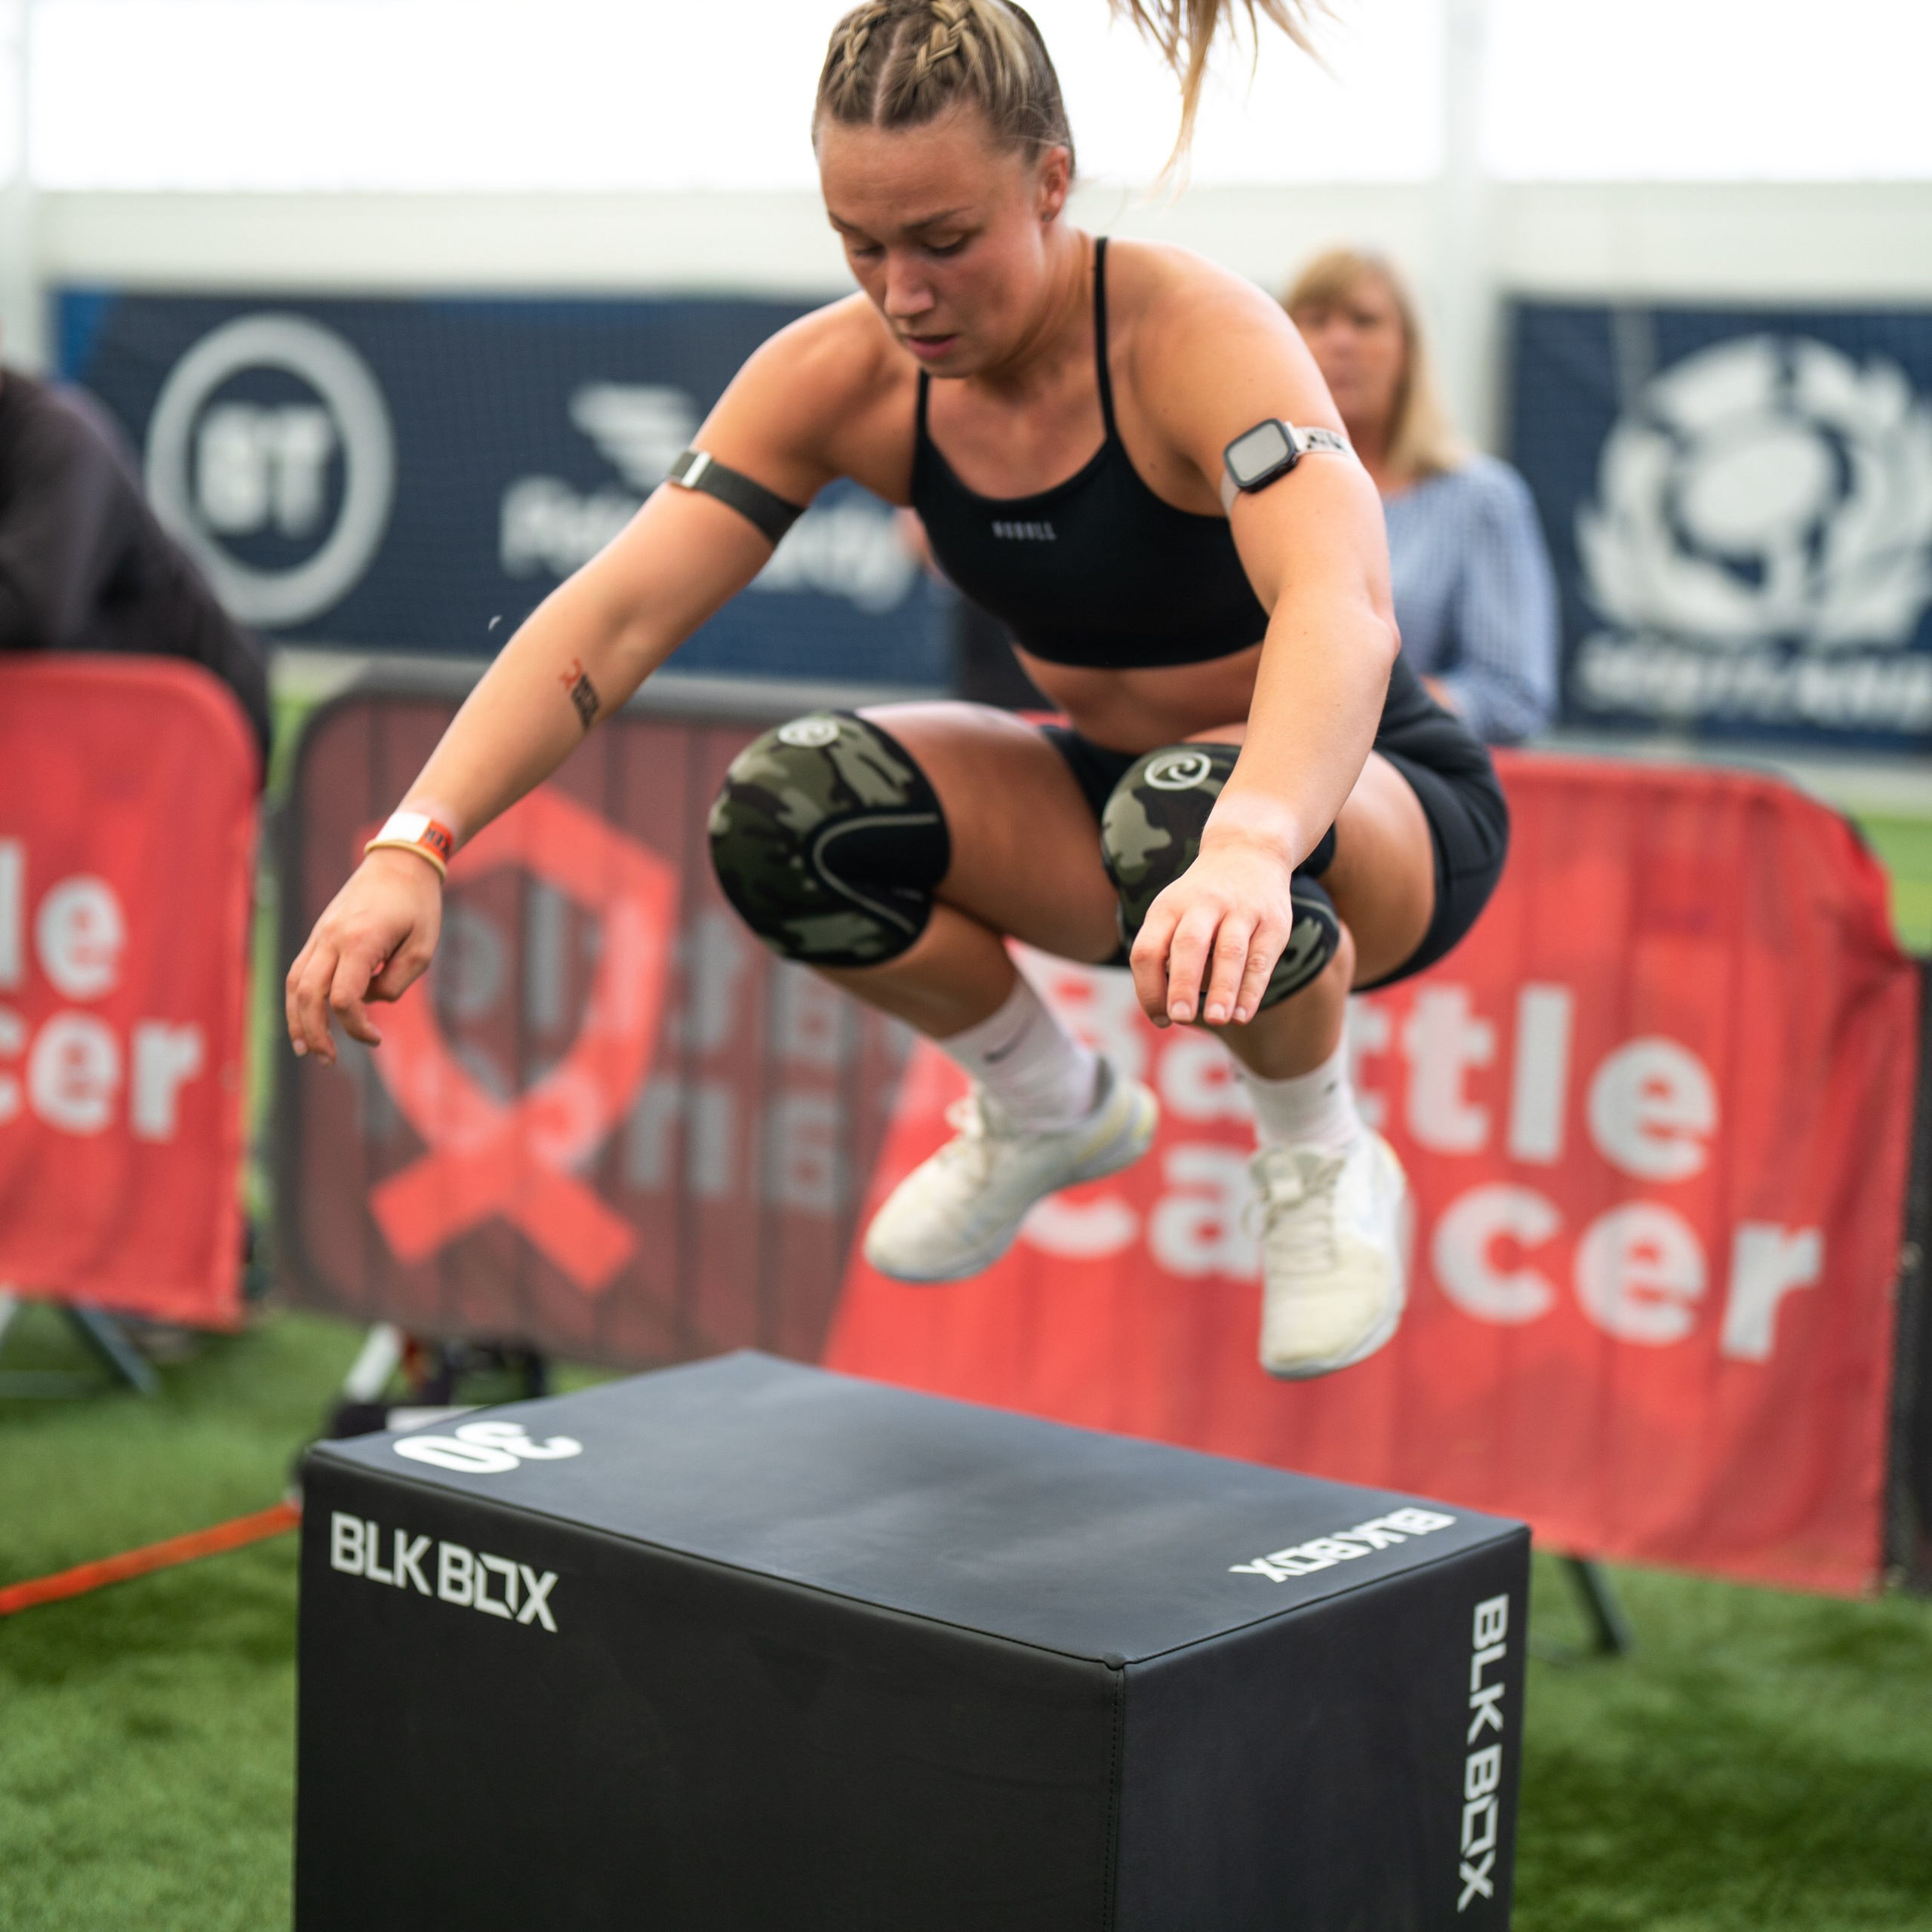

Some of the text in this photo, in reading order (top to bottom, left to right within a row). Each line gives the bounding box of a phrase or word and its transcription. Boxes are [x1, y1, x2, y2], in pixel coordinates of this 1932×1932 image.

[392, 1420, 583, 1473] 30
[330, 1510, 560, 1633] BLK BOX
[1227, 1506, 1457, 1583] BLK BOX
[1457, 1592, 1509, 1913] BLK BOX
